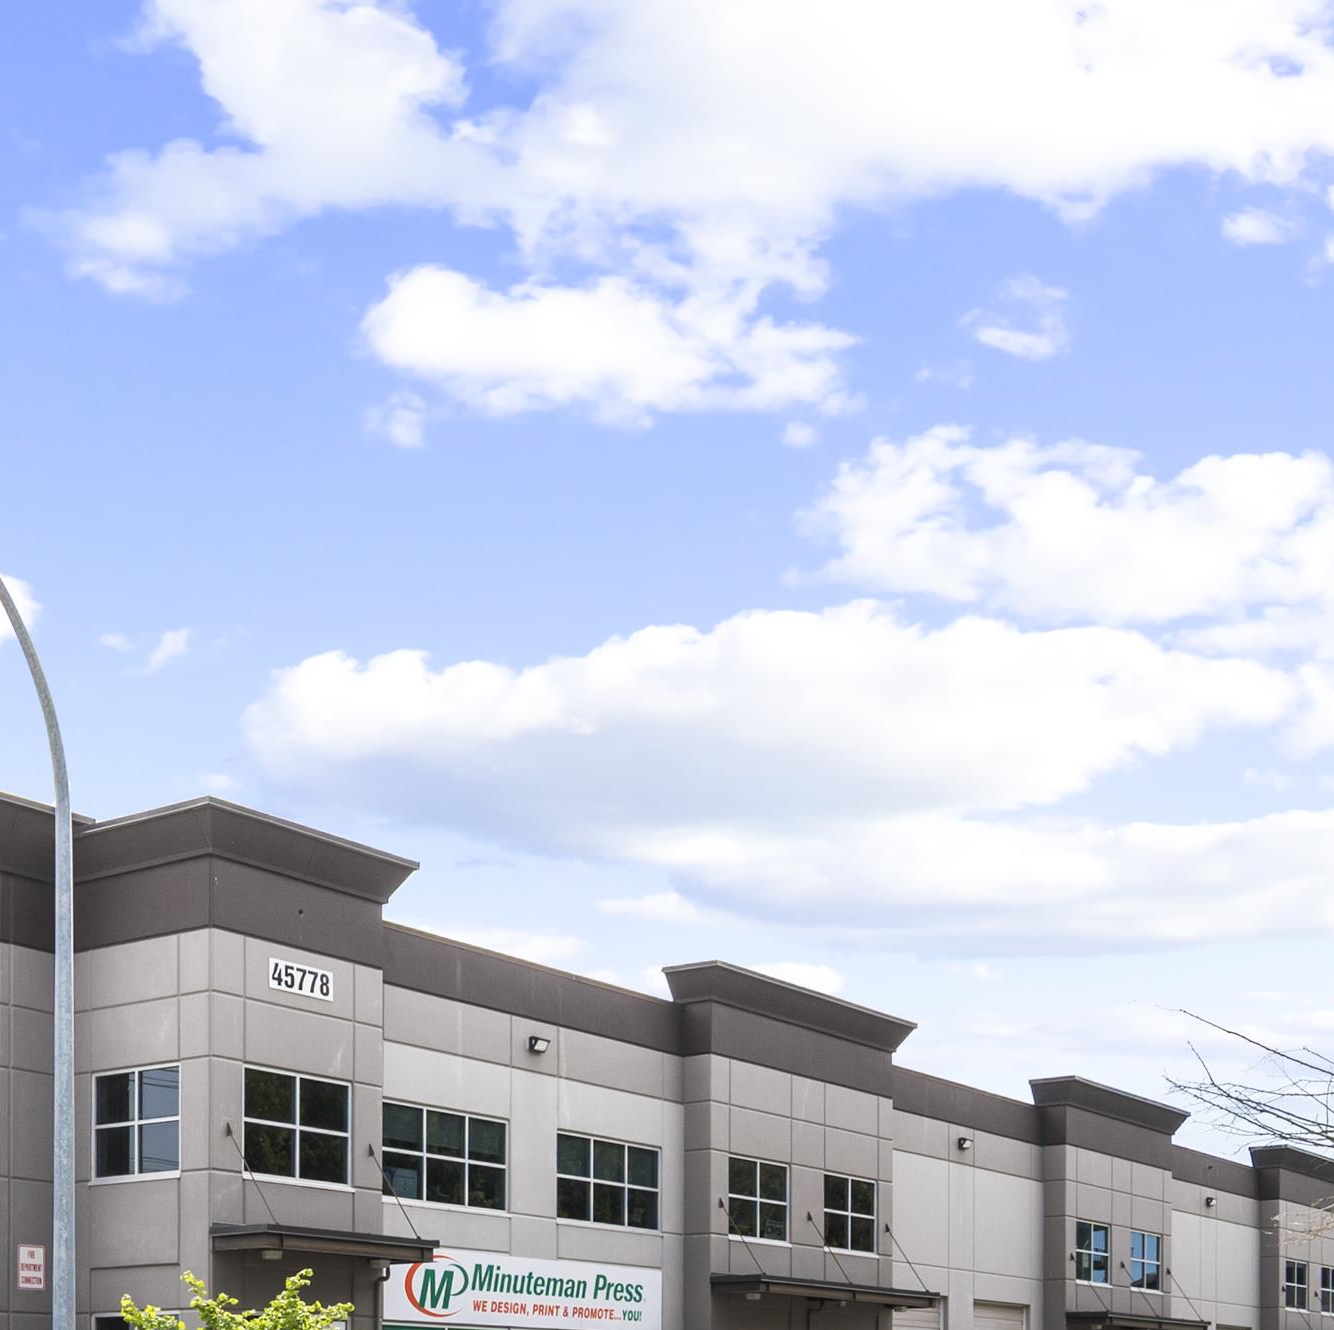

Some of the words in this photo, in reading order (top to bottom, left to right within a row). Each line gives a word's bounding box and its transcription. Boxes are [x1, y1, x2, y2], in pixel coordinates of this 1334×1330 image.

[272, 962, 329, 996] 45778
[471, 1263, 587, 1299] Minuteman
[593, 1274, 643, 1303] Press
[473, 1300, 488, 1312] WE
[491, 1301, 529, 1317] DESIGN,
[532, 1303, 560, 1317] PRINT
[563, 1306, 569, 1317] &
